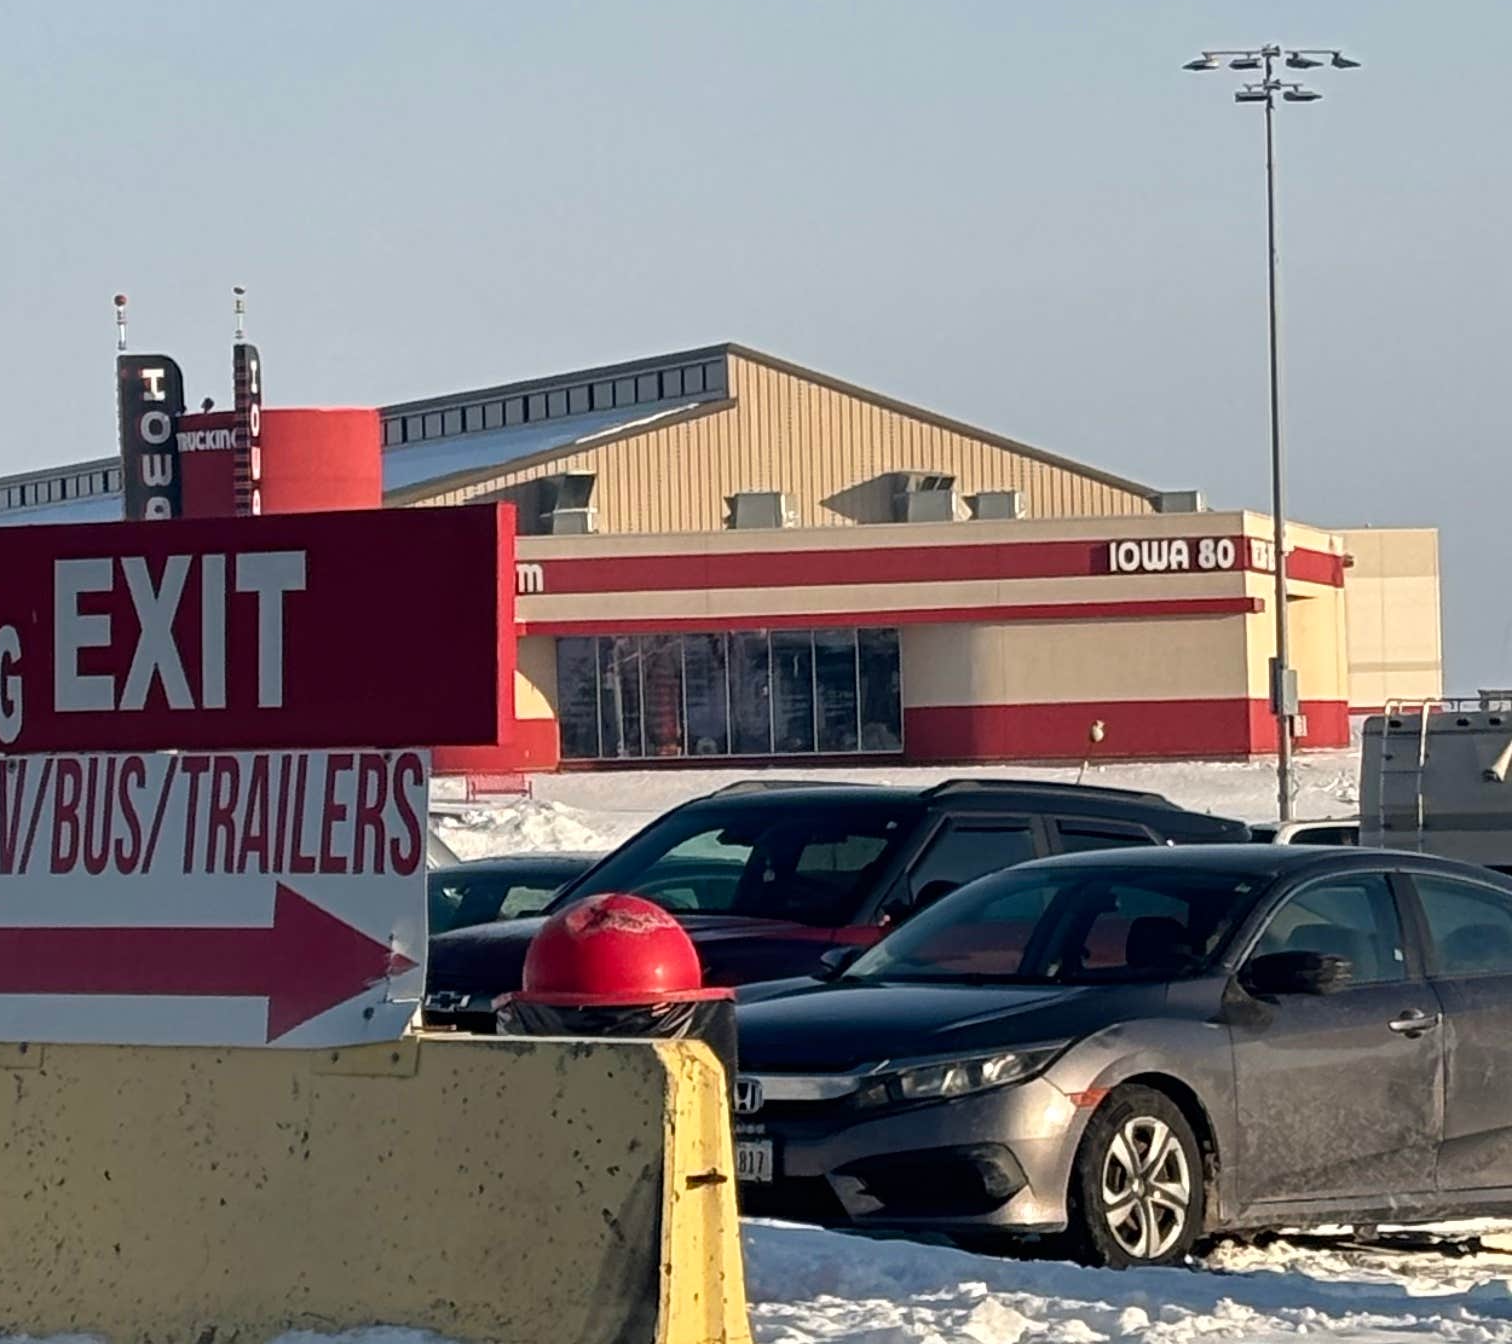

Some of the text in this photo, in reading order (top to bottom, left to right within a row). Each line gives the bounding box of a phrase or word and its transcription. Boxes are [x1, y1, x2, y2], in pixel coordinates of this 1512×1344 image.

[1109, 538, 1190, 573] IOWA
[1197, 538, 1235, 570] 80
[54, 550, 307, 712] EXIT
